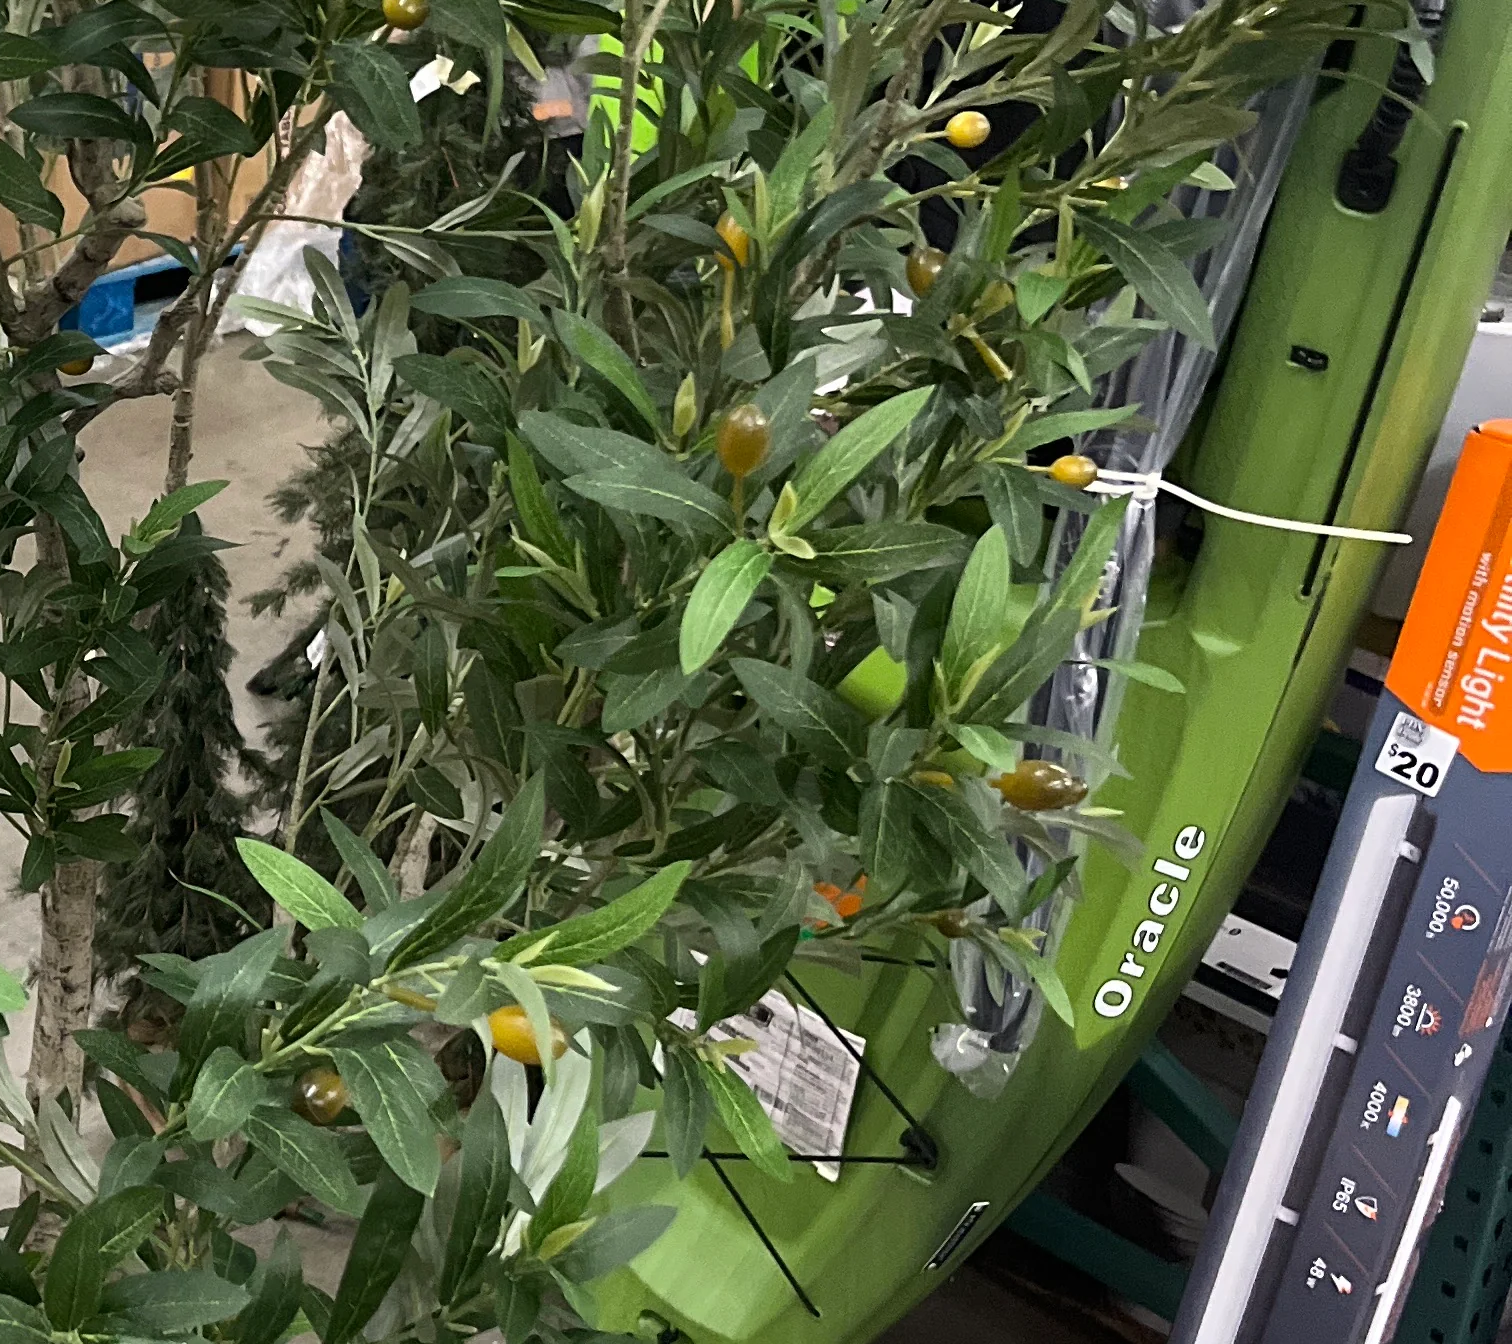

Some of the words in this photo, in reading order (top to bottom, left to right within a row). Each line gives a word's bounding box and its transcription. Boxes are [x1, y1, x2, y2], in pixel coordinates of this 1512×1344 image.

[1471, 551, 1493, 588] with
[1451, 589, 1479, 648] motion
[1433, 649, 1459, 708] sensor
[1456, 647, 1511, 730] Light
[1388, 742, 1440, 788] $20
[1092, 824, 1207, 1019] Oracle
[1332, 1176, 1357, 1214] IP65
